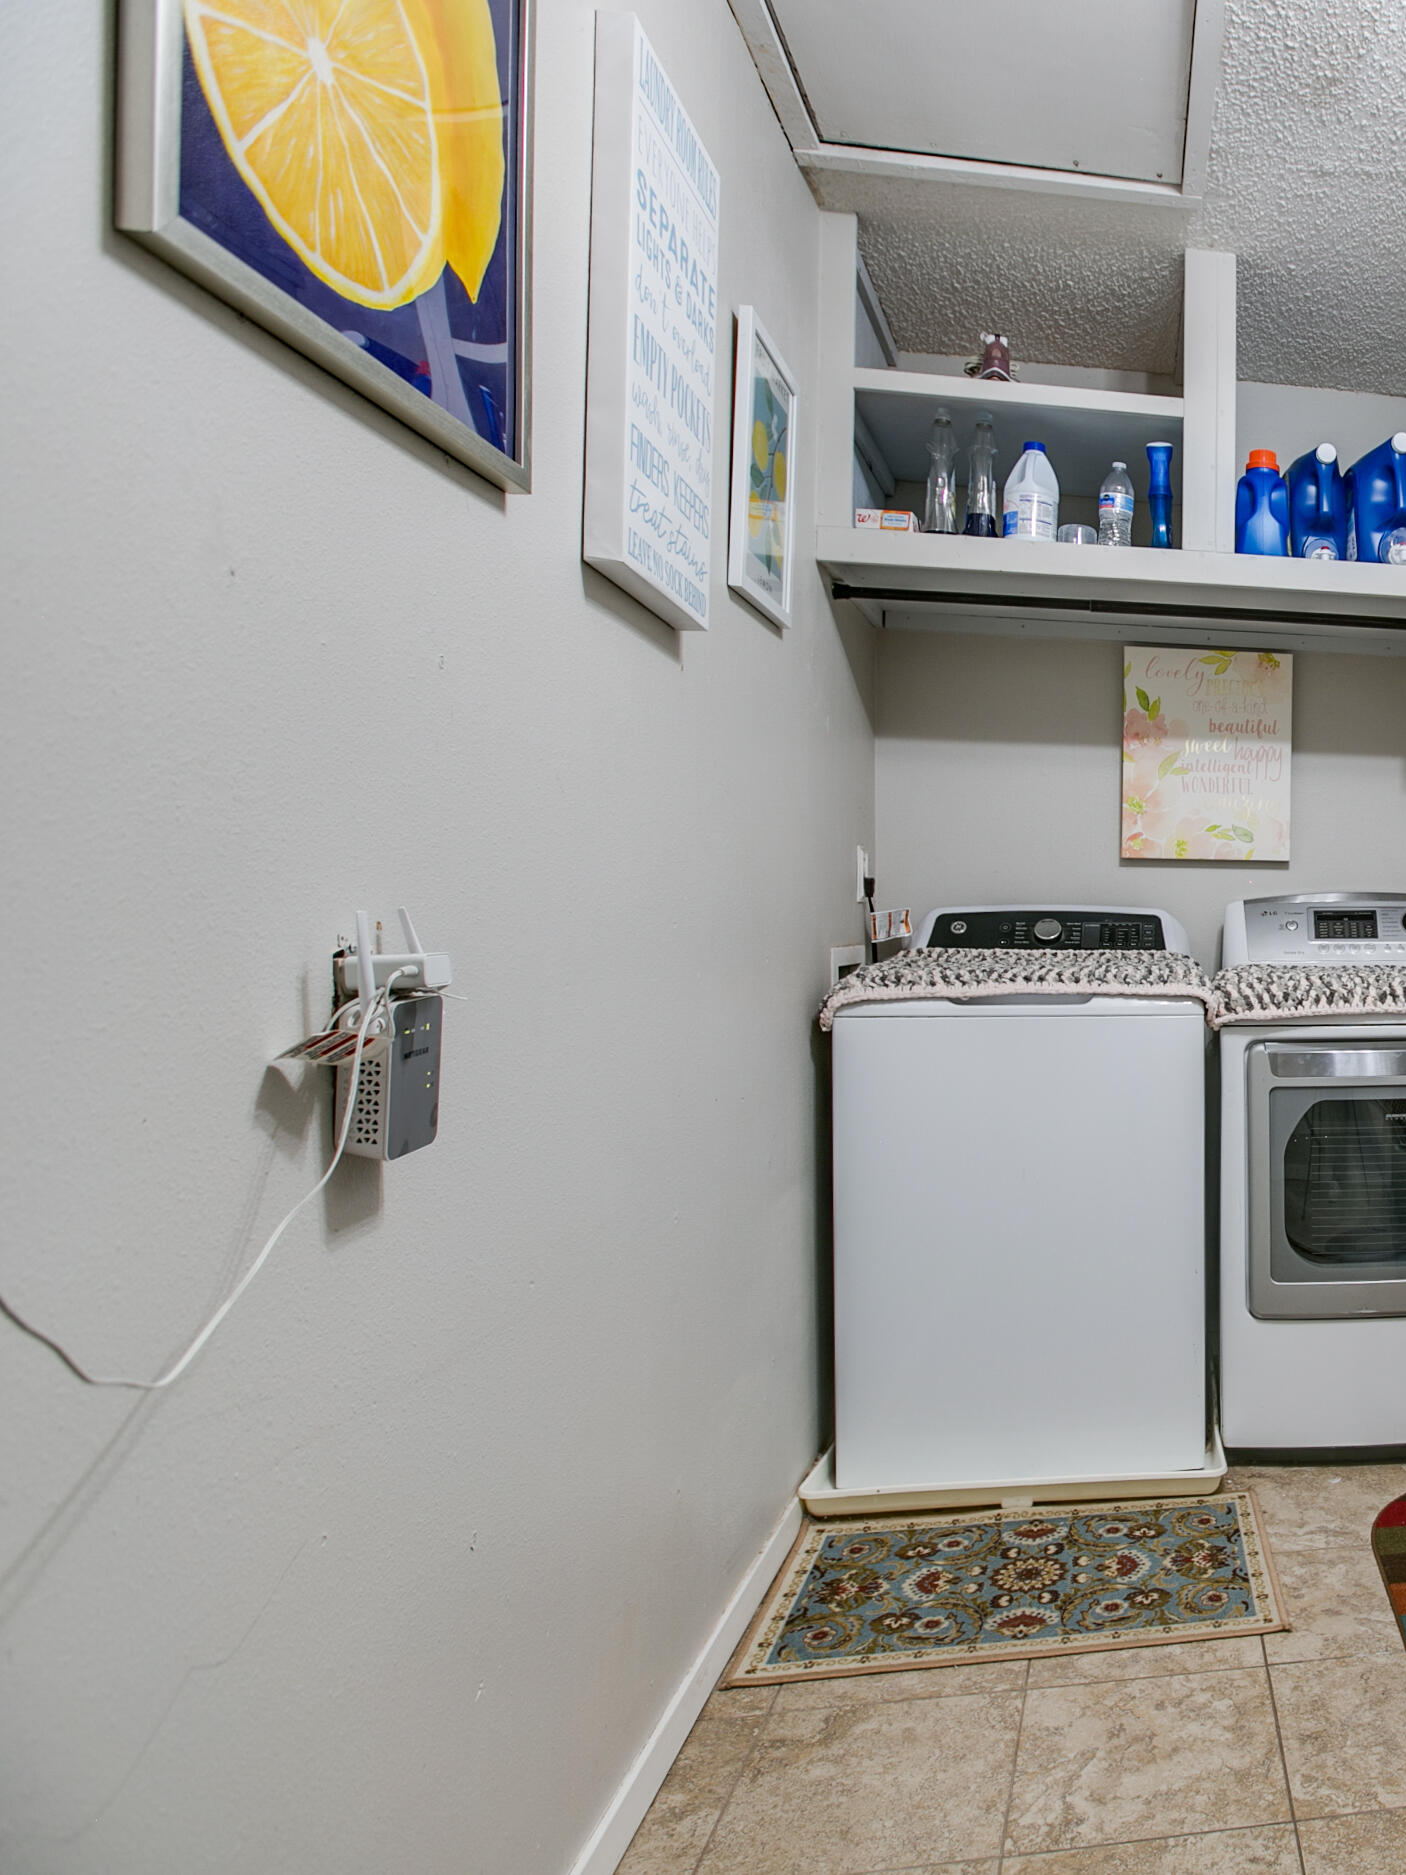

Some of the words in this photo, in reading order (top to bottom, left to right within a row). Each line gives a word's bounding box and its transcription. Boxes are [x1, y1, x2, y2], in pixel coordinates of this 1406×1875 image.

[637, 114, 689, 234] EVERYONE
[638, 36, 674, 146] LAUNDRY
[675, 103, 696, 184] ROOM
[697, 146, 717, 220] RULES
[636, 167, 716, 320] SEPARATE
[636, 212, 671, 290] LIGHTS
[685, 292, 714, 354] DARKS
[632, 312, 667, 400] EMPTY
[670, 363, 711, 453] POCKETS
[629, 477, 672, 539] treat
[667, 522, 708, 583] stains
[630, 422, 670, 498] FINDERS
[673, 467, 709, 540] KEEPERS
[628, 526, 653, 573] LEAVE
[653, 551, 664, 581] NO
[664, 559, 683, 601] SOCK
[684, 577, 706, 618] BEHIND
[1145, 655, 1205, 696] lovely
[1208, 718, 1280, 739] beautiful
[1180, 758, 1252, 776] intelligent
[1183, 736, 1230, 756] sweet
[1233, 736, 1283, 782] happy
